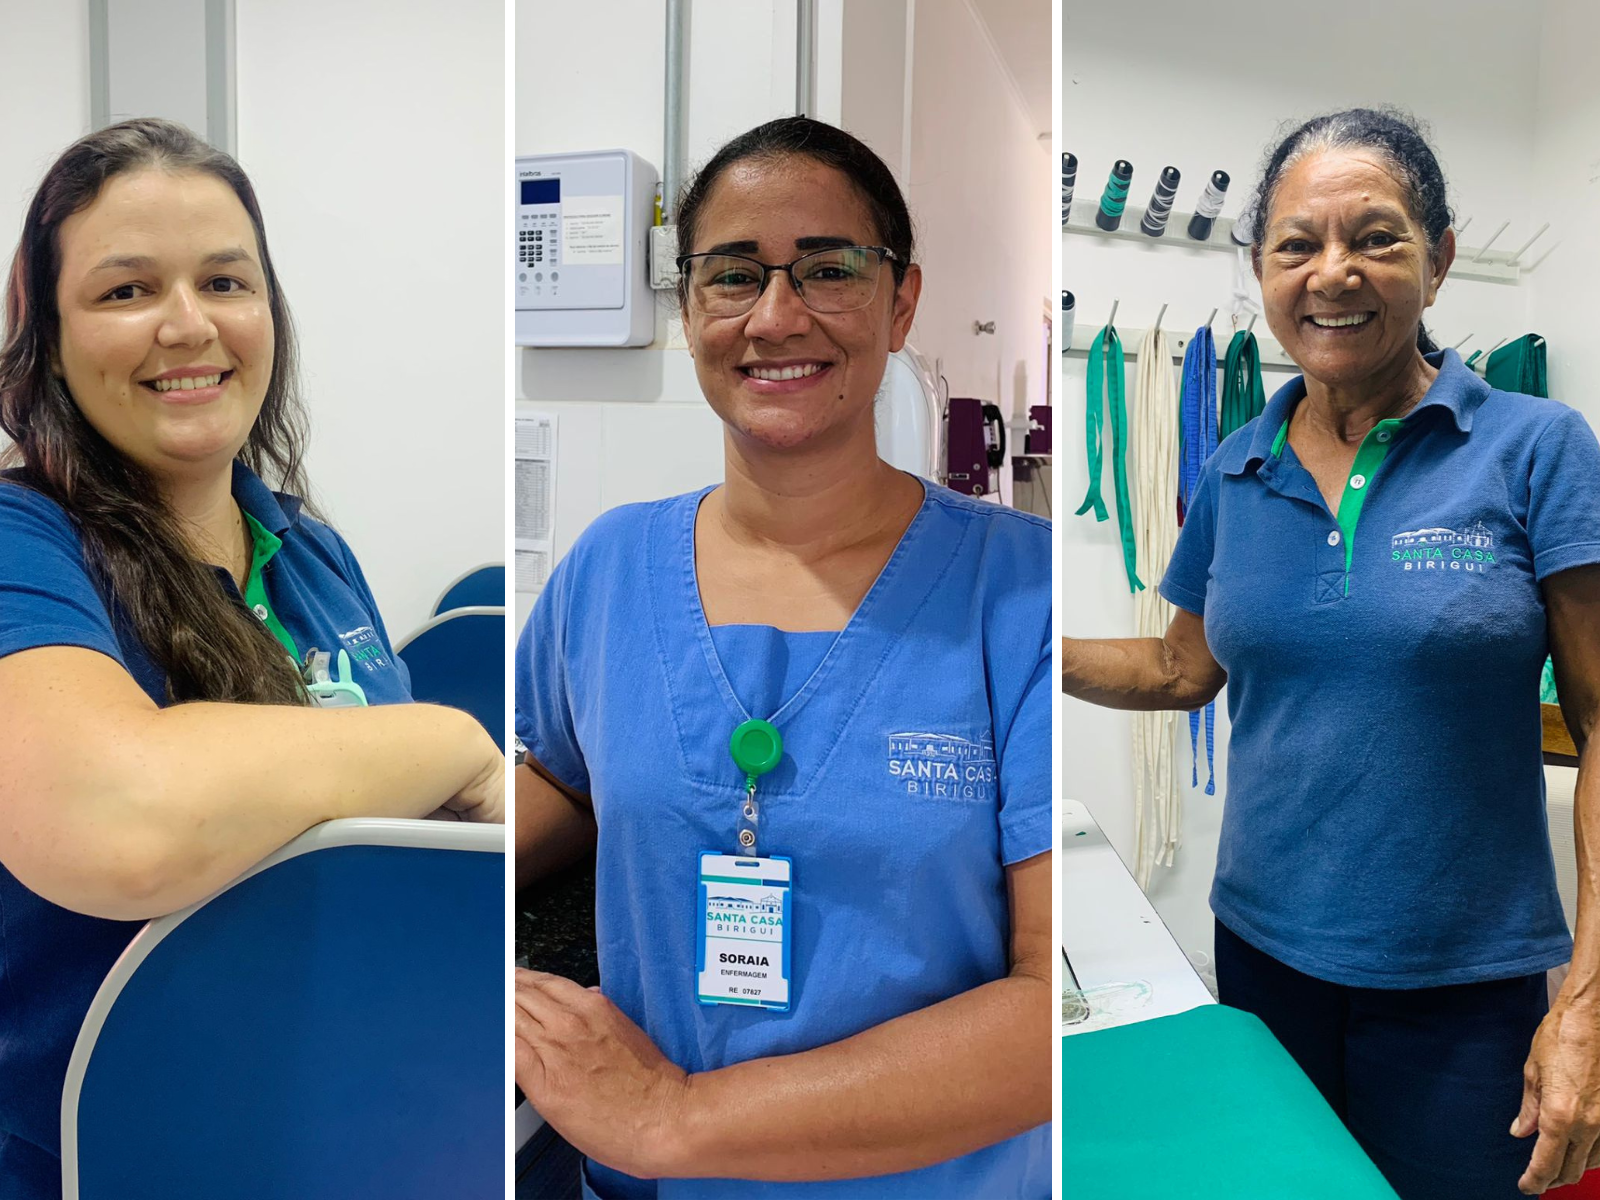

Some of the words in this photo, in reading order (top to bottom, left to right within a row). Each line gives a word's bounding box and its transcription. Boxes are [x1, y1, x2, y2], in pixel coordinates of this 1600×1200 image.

[1391, 546, 1444, 561] SANTA
[1451, 547, 1497, 565] CASA
[1404, 560, 1484, 573] BIRIGUI
[888, 760, 959, 780] SANTA
[964, 766, 998, 784] CAS
[706, 911, 747, 924] SANTA
[750, 915, 784, 927] CASA
[717, 923, 774, 936] BIRIGUI
[719, 953, 770, 967] SORAIA
[720, 969, 768, 979] ENFERMAGEM
[728, 986, 739, 994] RE
